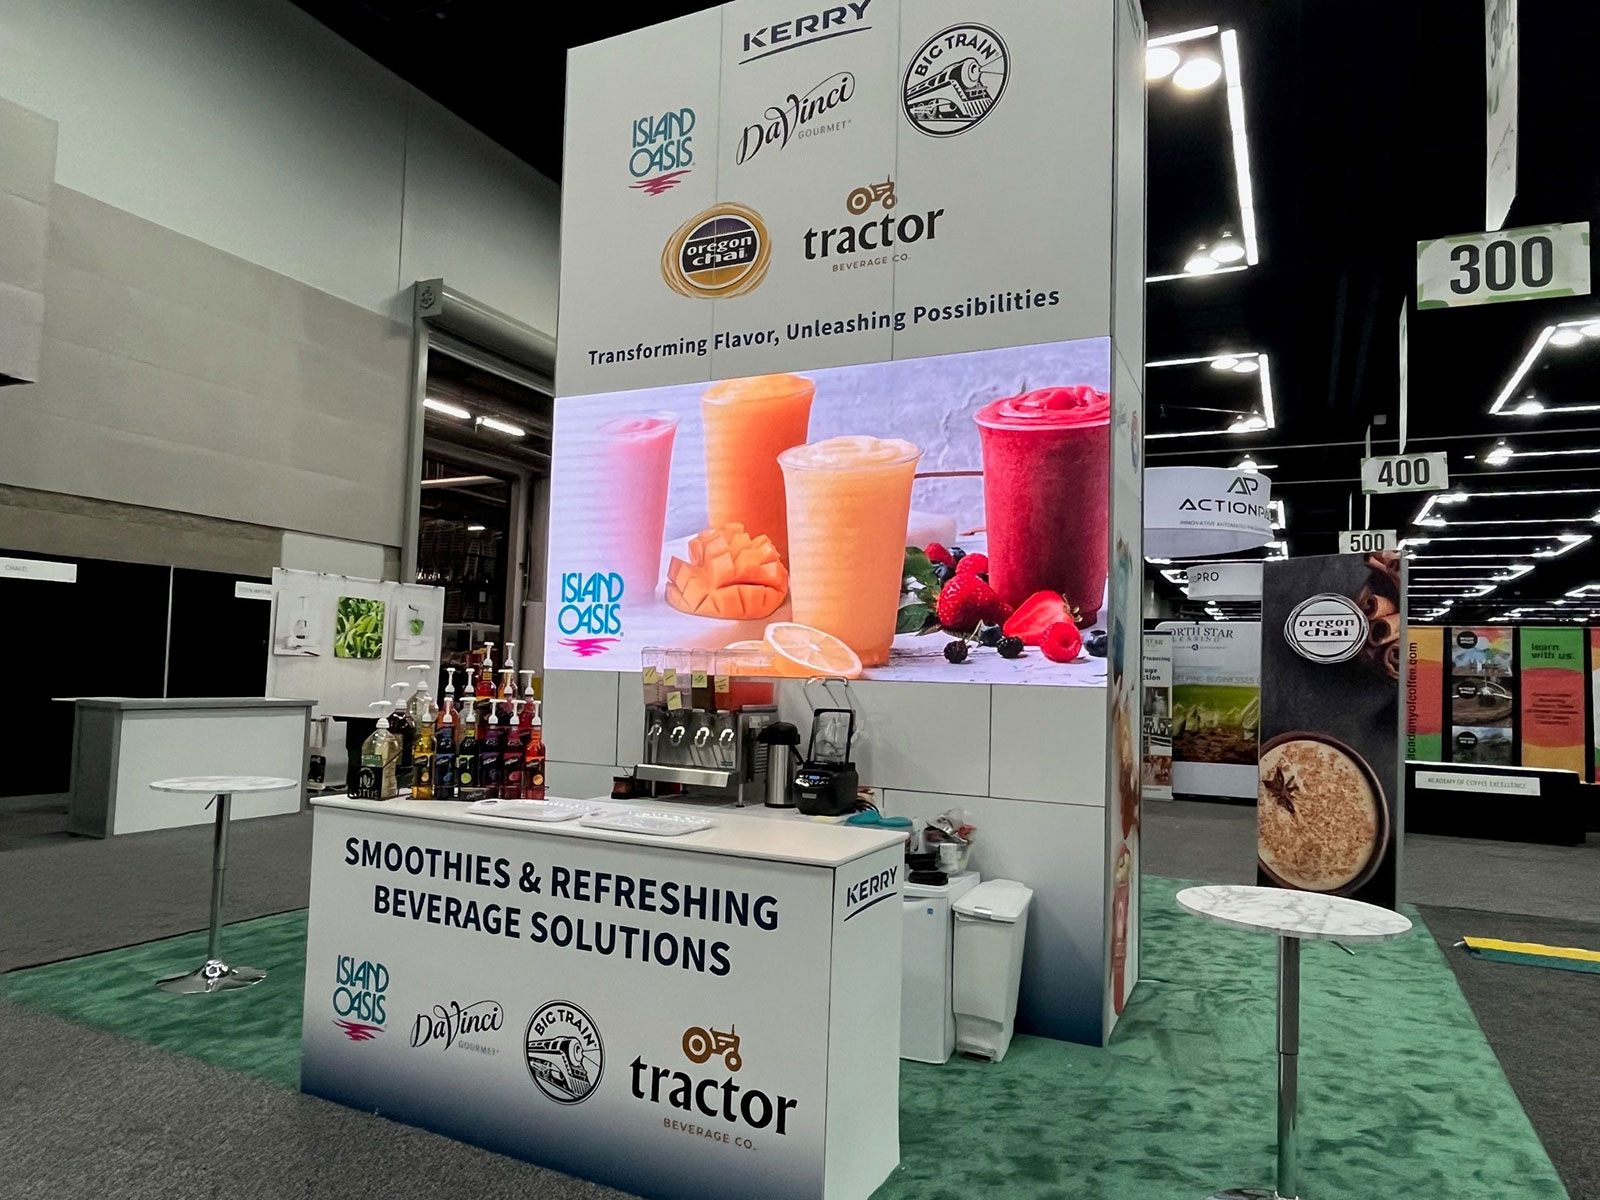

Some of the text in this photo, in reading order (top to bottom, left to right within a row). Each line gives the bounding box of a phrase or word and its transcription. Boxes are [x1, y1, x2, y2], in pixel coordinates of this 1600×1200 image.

[743, 0, 872, 51] KERRY
[915, 33, 996, 76] BIG TRAIN
[633, 108, 695, 148] ISLAND
[736, 71, 855, 165] DaVinci
[798, 120, 846, 139] GOURMET
[629, 137, 693, 177] OASIS
[687, 236, 752, 256] oregon
[803, 209, 944, 260] tractor
[692, 248, 745, 266] chai
[832, 253, 911, 272] BEVERAGE CO.
[1450, 236, 1553, 295] 300
[588, 289, 1060, 365] Transforming Flavor, Unleashing Possibilities
[1378, 458, 1430, 487] 400
[1350, 534, 1385, 552] 500
[562, 572, 624, 603] ISLAND
[557, 603, 622, 635] OASIS
[1203, 626, 1234, 638] STAR
[1299, 619, 1355, 629] oregon
[1304, 628, 1349, 637] chai
[1531, 643, 1560, 651] learn
[1531, 651, 1556, 659] with
[345, 837, 778, 931] SMOOTHIES & REFRESHING
[847, 865, 898, 907] KERRY
[374, 885, 731, 976] BEVERAGE SOLUTIONS
[336, 955, 389, 993] ISLAND
[333, 987, 386, 1025] OASIS
[410, 1000, 504, 1052] DaVinci
[534, 1009, 596, 1046] BIG TRAIN
[458, 1040, 496, 1055] GOURMET
[629, 1055, 798, 1135] tractor
[663, 1118, 756, 1151] BEVERAGE CO.
